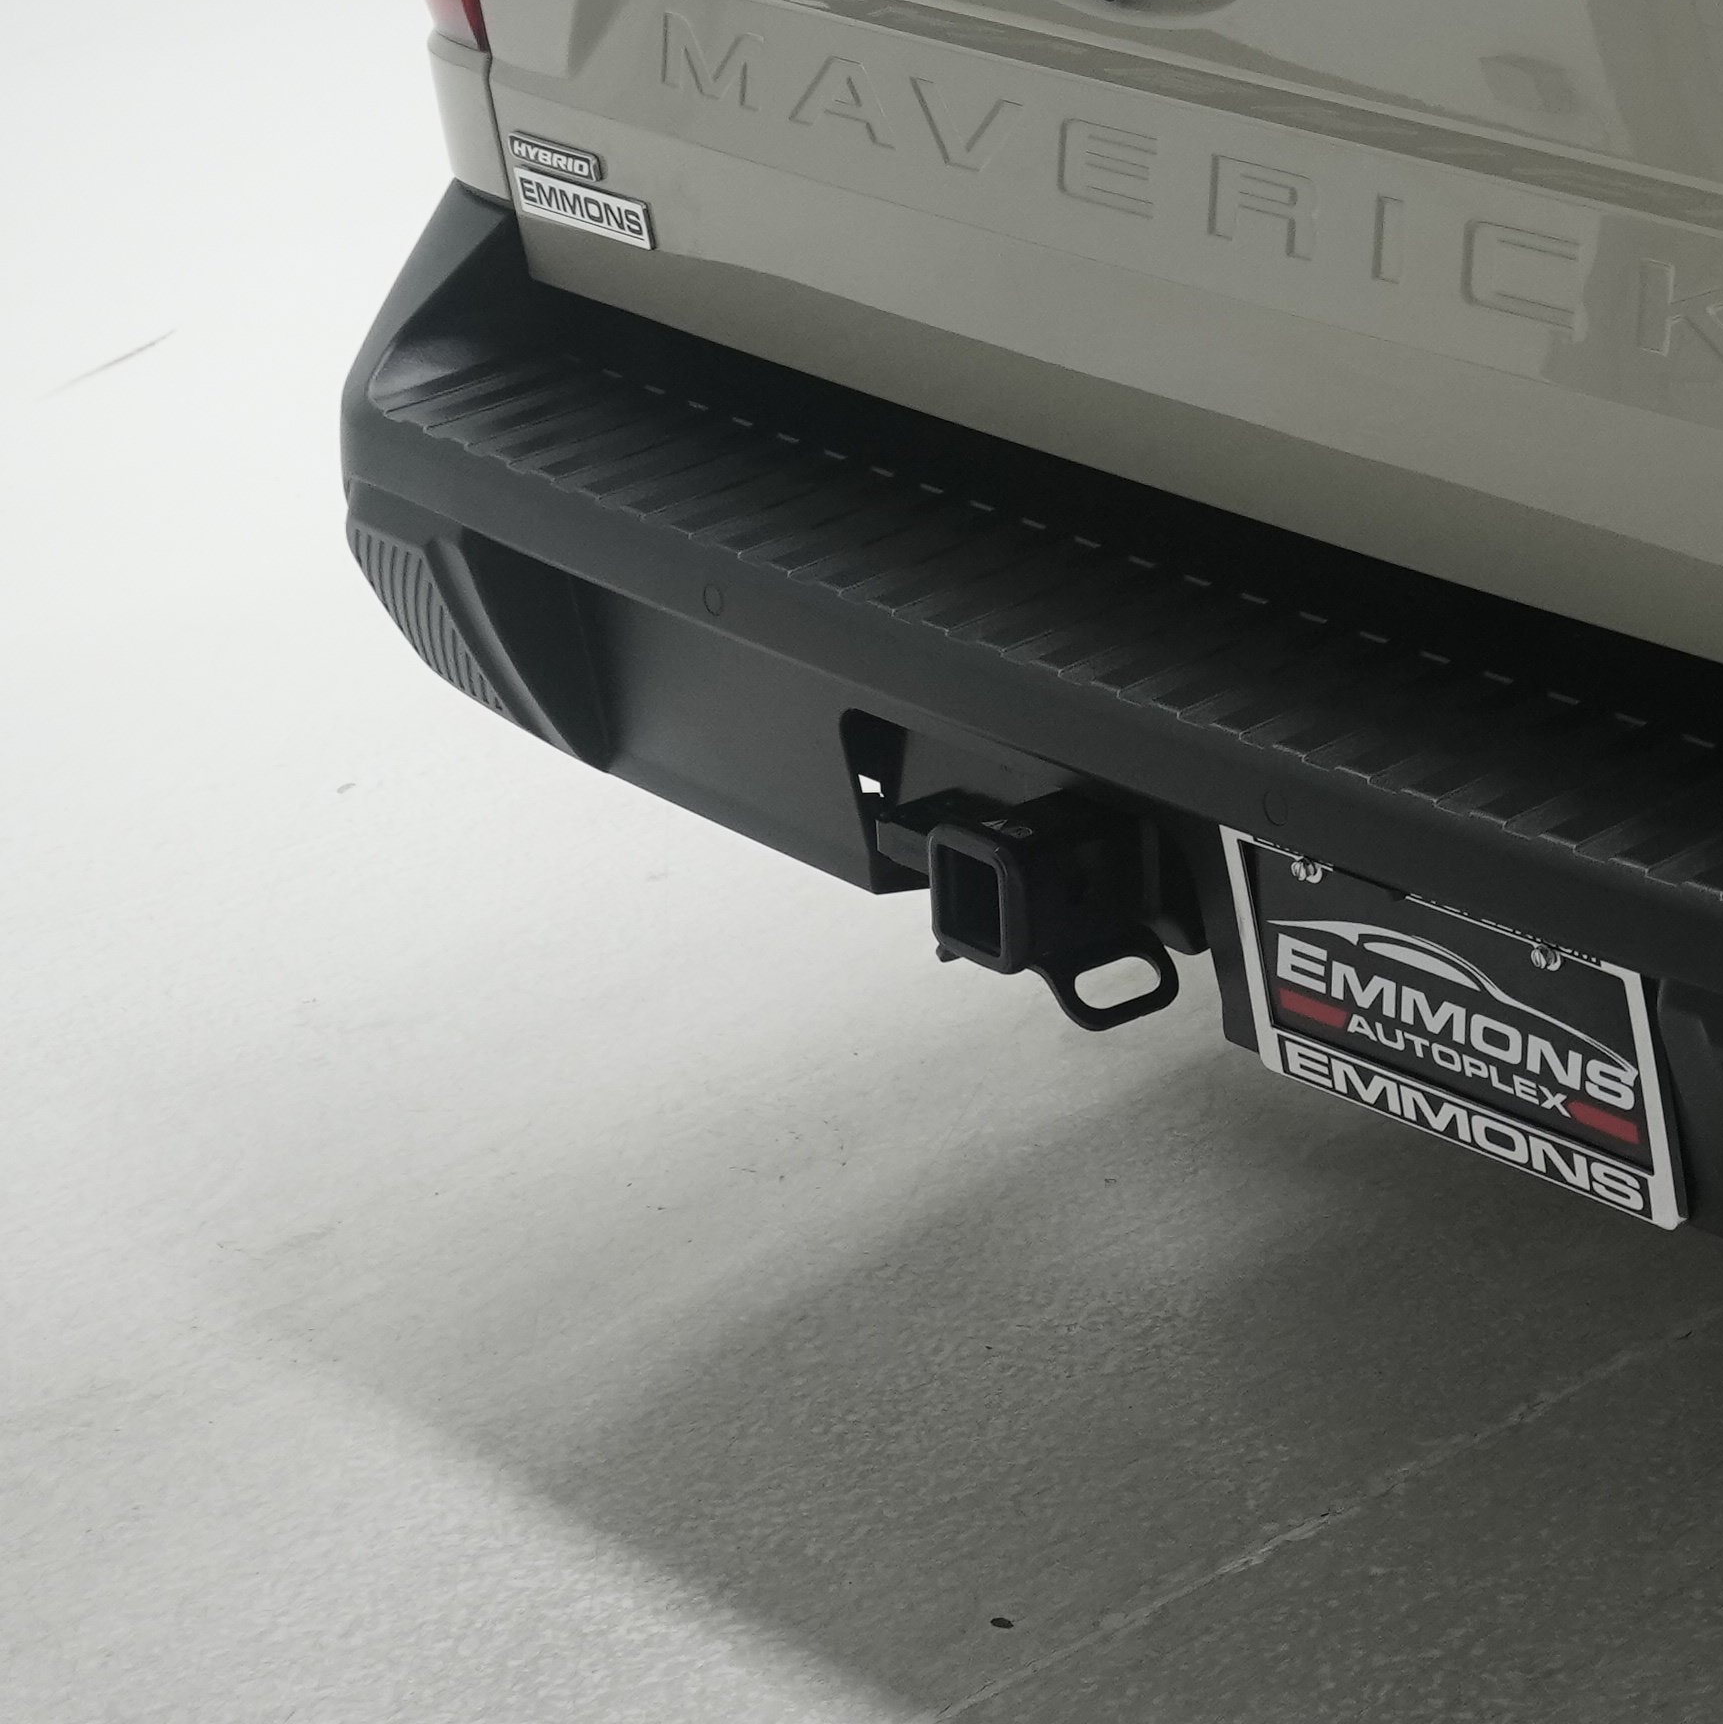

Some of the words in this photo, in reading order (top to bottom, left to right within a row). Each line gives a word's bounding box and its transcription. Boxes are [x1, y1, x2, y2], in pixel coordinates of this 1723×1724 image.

[513, 140, 590, 176] HYBRID
[519, 177, 643, 236] EMMONS
[1277, 932, 1635, 1110] EMMONS
[1347, 1013, 1572, 1117] AUTOPLEX
[1284, 1039, 1645, 1211] EMMONS
